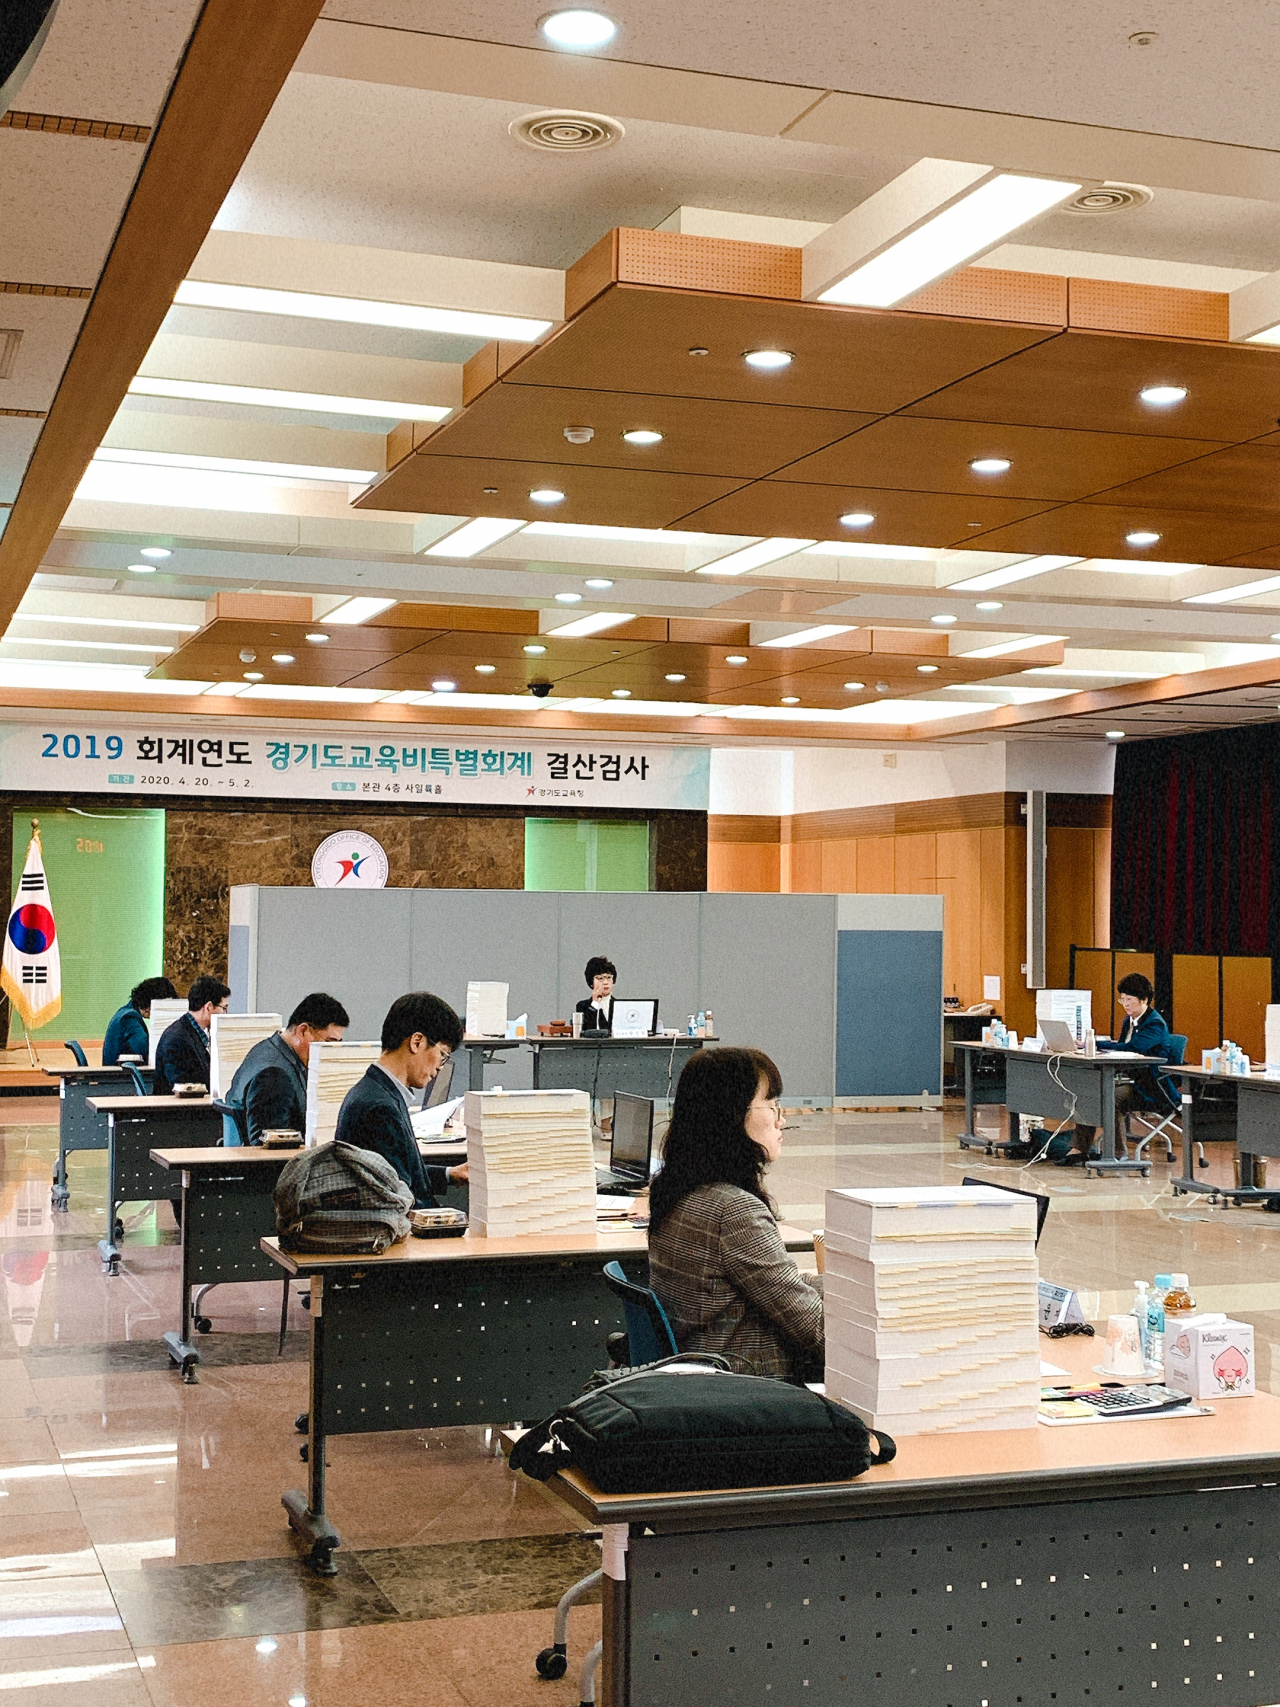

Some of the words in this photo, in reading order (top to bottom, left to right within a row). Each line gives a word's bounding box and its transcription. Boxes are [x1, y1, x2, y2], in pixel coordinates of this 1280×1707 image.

[41, 733, 123, 760] 2019
[136, 736, 253, 768] 회계연도
[265, 741, 533, 777] 경기도교육비특별회계
[546, 752, 650, 782] 결산검사
[140, 775, 174, 786] 2020.
[178, 777, 190, 787] 4.
[194, 777, 213, 788] 20.
[228, 778, 239, 788] 5.
[243, 779, 255, 789] 2.
[361, 782, 381, 793] 본관
[384, 783, 401, 794] 4층
[538, 788, 584, 798] 경기도교육청
[336, 833, 360, 842] OFFICE
[361, 837, 371, 845] OF
[369, 843, 386, 880] EDUCATION
